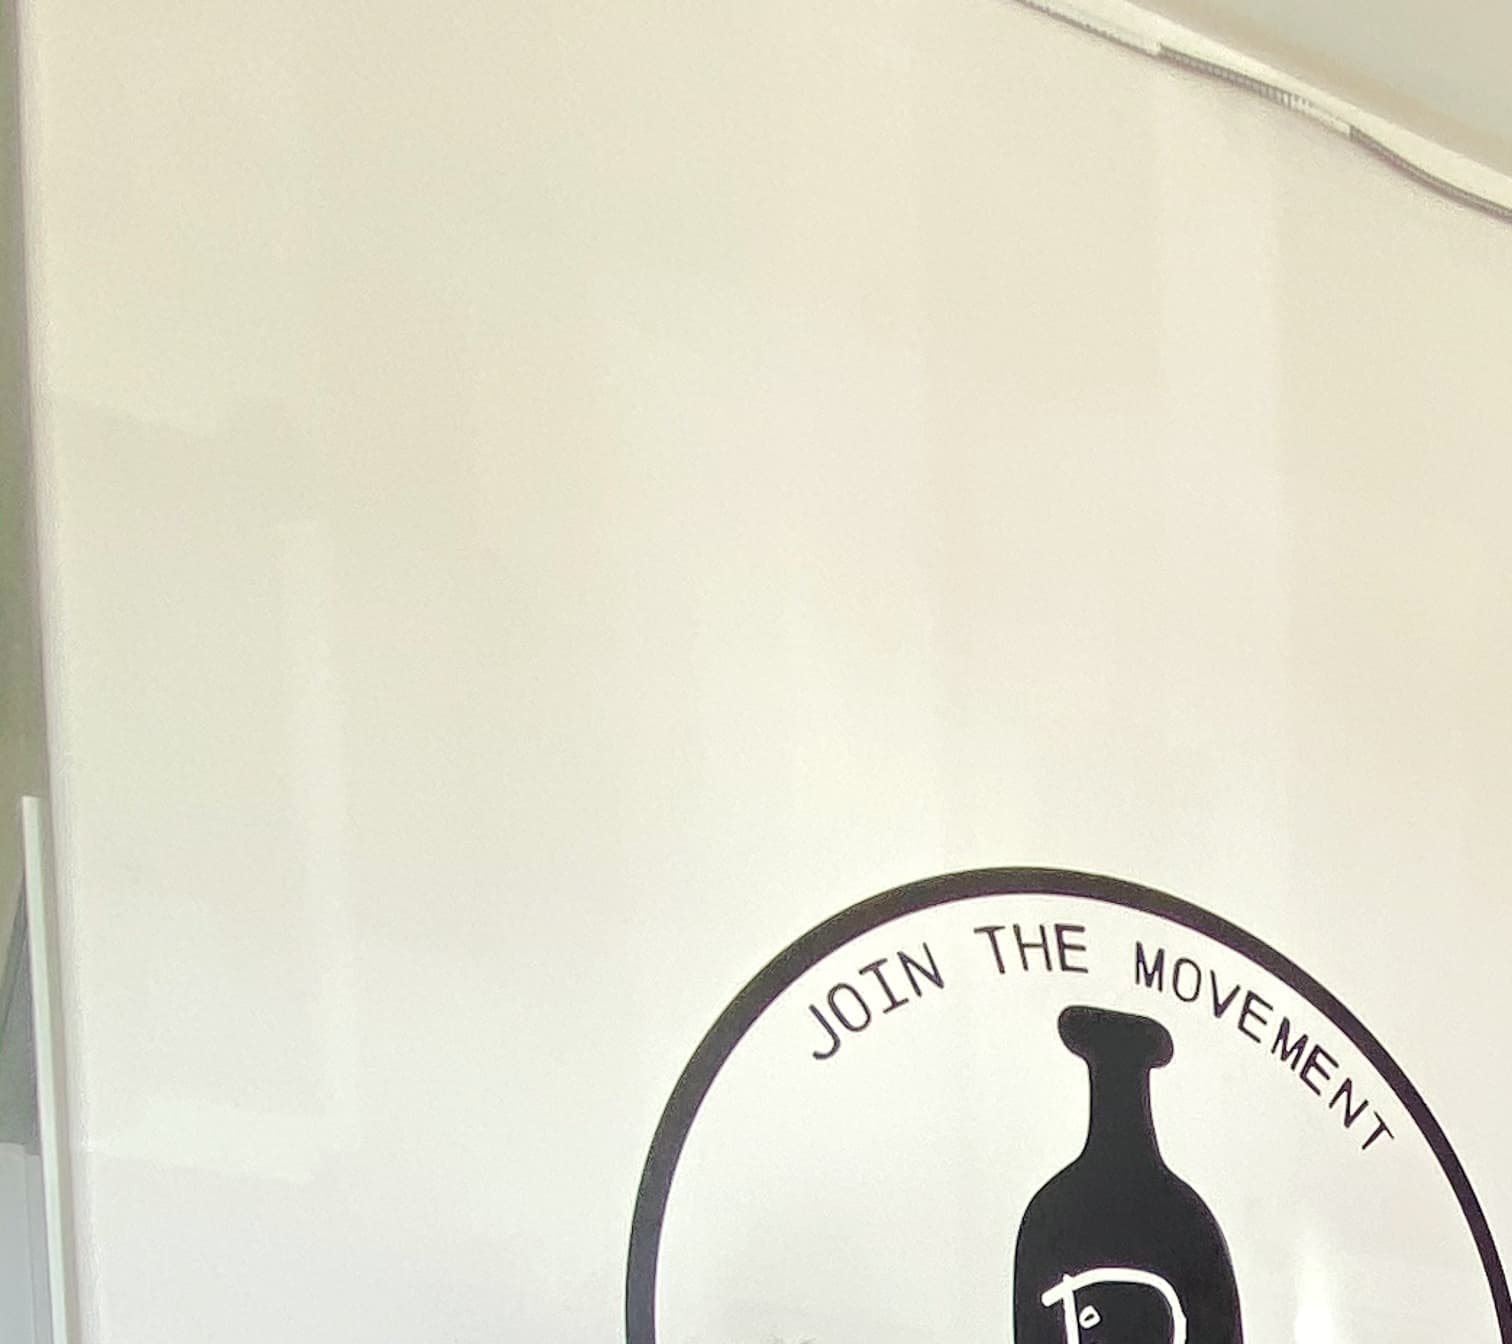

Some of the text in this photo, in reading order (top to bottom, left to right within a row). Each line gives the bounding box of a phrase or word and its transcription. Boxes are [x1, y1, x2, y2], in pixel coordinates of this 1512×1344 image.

[808, 923, 1395, 1151] JOIN THE MOVEMENT
